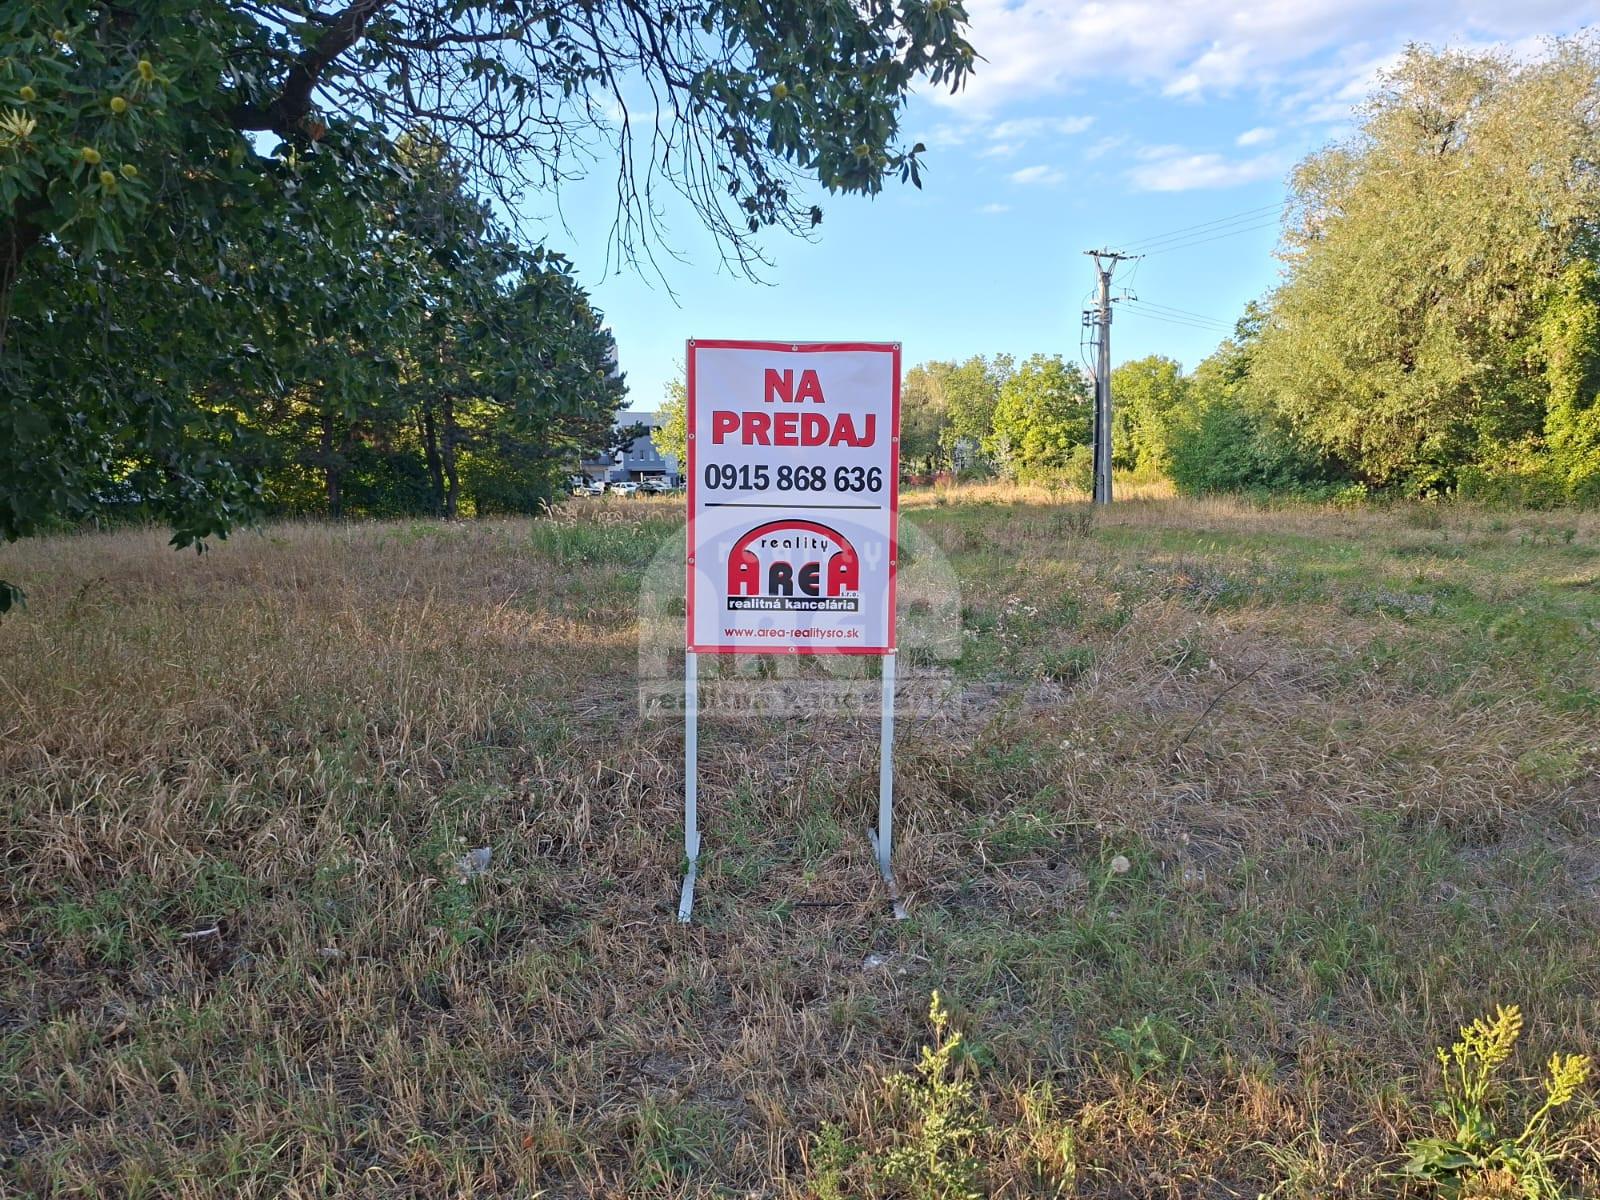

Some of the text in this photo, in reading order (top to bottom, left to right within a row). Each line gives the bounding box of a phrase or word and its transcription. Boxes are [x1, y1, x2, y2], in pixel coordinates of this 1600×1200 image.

[764, 368, 825, 403] NA
[712, 410, 876, 447] PREDAJ
[704, 463, 882, 492] 0915 868 636
[761, 536, 829, 552] reality
[728, 550, 859, 597] AREA
[729, 599, 855, 610] realitná kancelária
[724, 627, 859, 639] www.area-realitysro.sk
